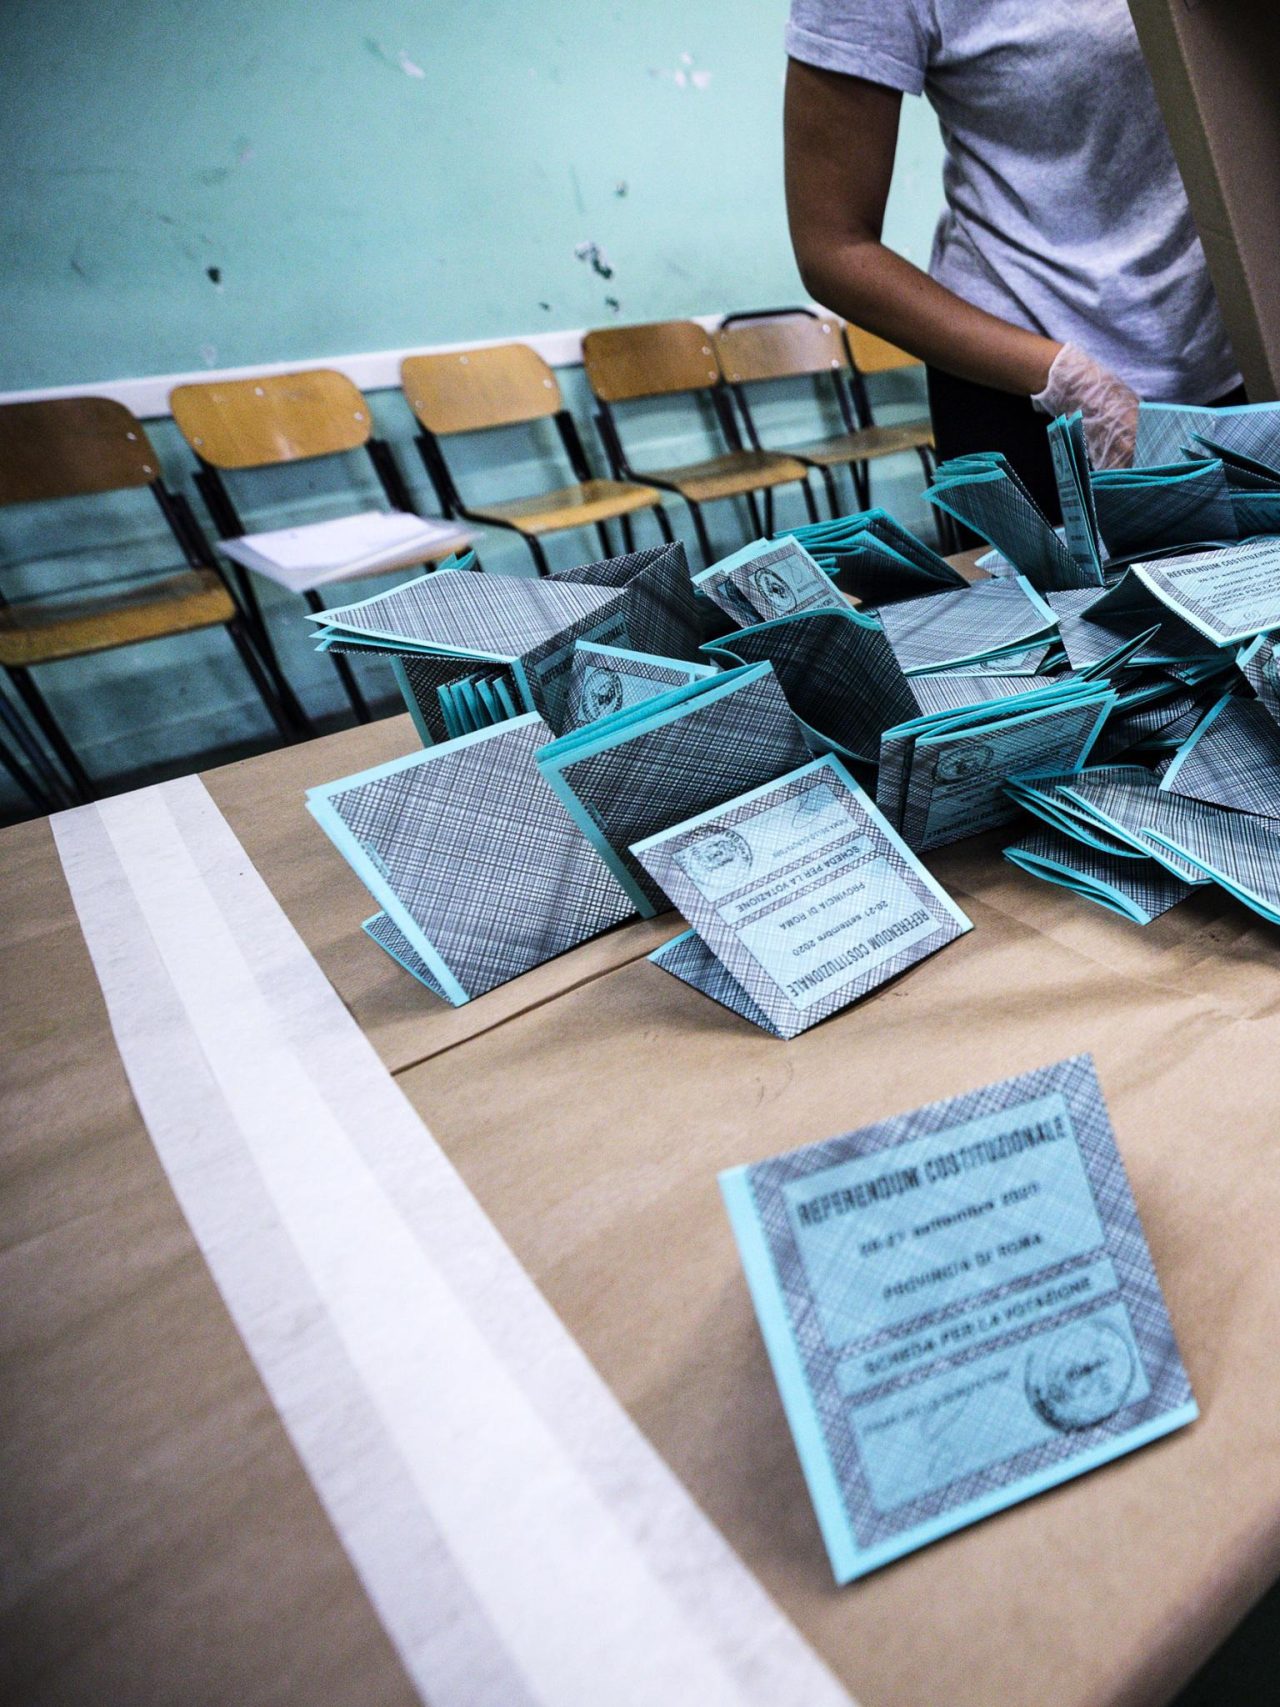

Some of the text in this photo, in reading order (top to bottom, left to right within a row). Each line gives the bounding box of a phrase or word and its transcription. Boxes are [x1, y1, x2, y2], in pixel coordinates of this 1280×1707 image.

[1165, 563, 1223, 578] REFERENDUM
[735, 844, 859, 912] SCHEDA PER LA VOTAZIONE
[778, 881, 865, 931] PROVINCIA DI ROMA
[786, 909, 929, 996] REFERENDUM COSTITUZIONALE
[791, 899, 888, 957] 20-21 settembre 2020
[922, 1116, 1065, 1183] COSTITUZIONALE
[995, 1230, 1042, 1258] ROMA
[865, 1337, 935, 1377] SCHEDA
[939, 1321, 975, 1346] PER
[1004, 1275, 1091, 1321] VOTAZIONE
